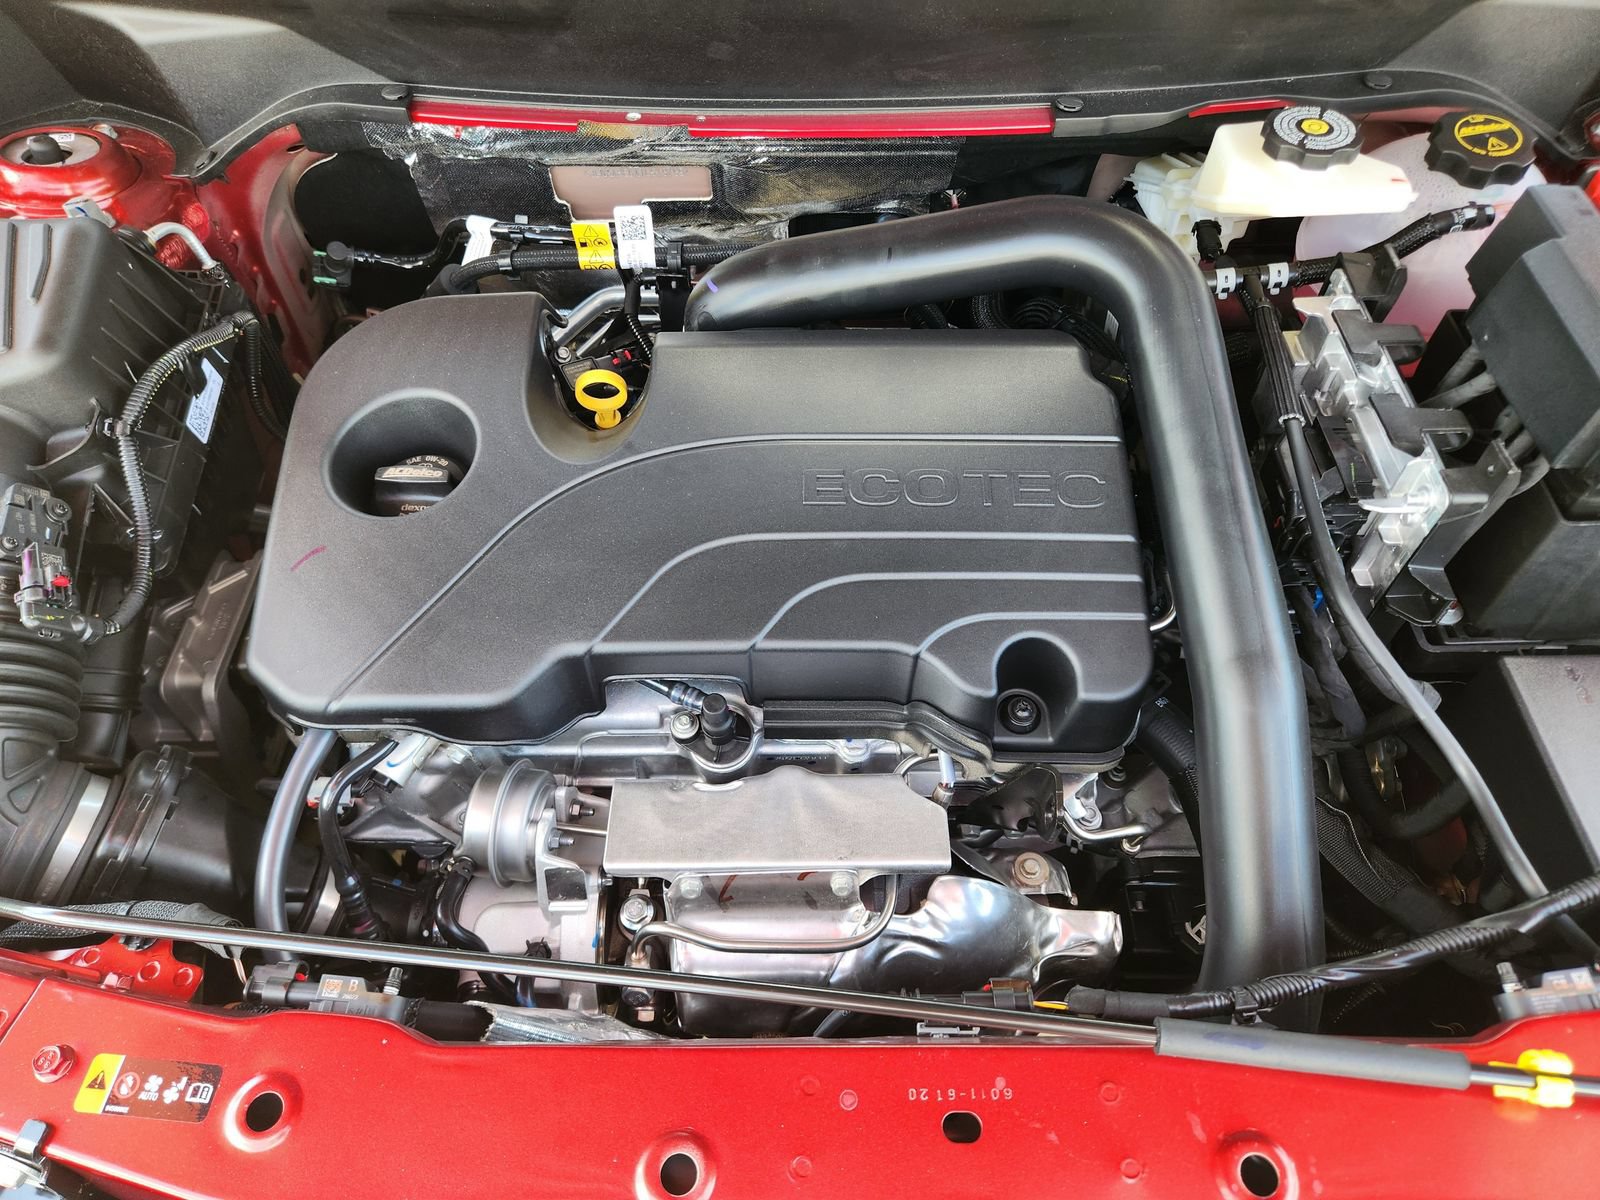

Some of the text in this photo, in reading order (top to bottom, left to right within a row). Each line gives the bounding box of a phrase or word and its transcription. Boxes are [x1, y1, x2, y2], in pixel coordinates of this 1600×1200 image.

[802, 468, 1106, 508] ECOTEC
[348, 979, 359, 992] B
[138, 1090, 159, 1102] AUTO
